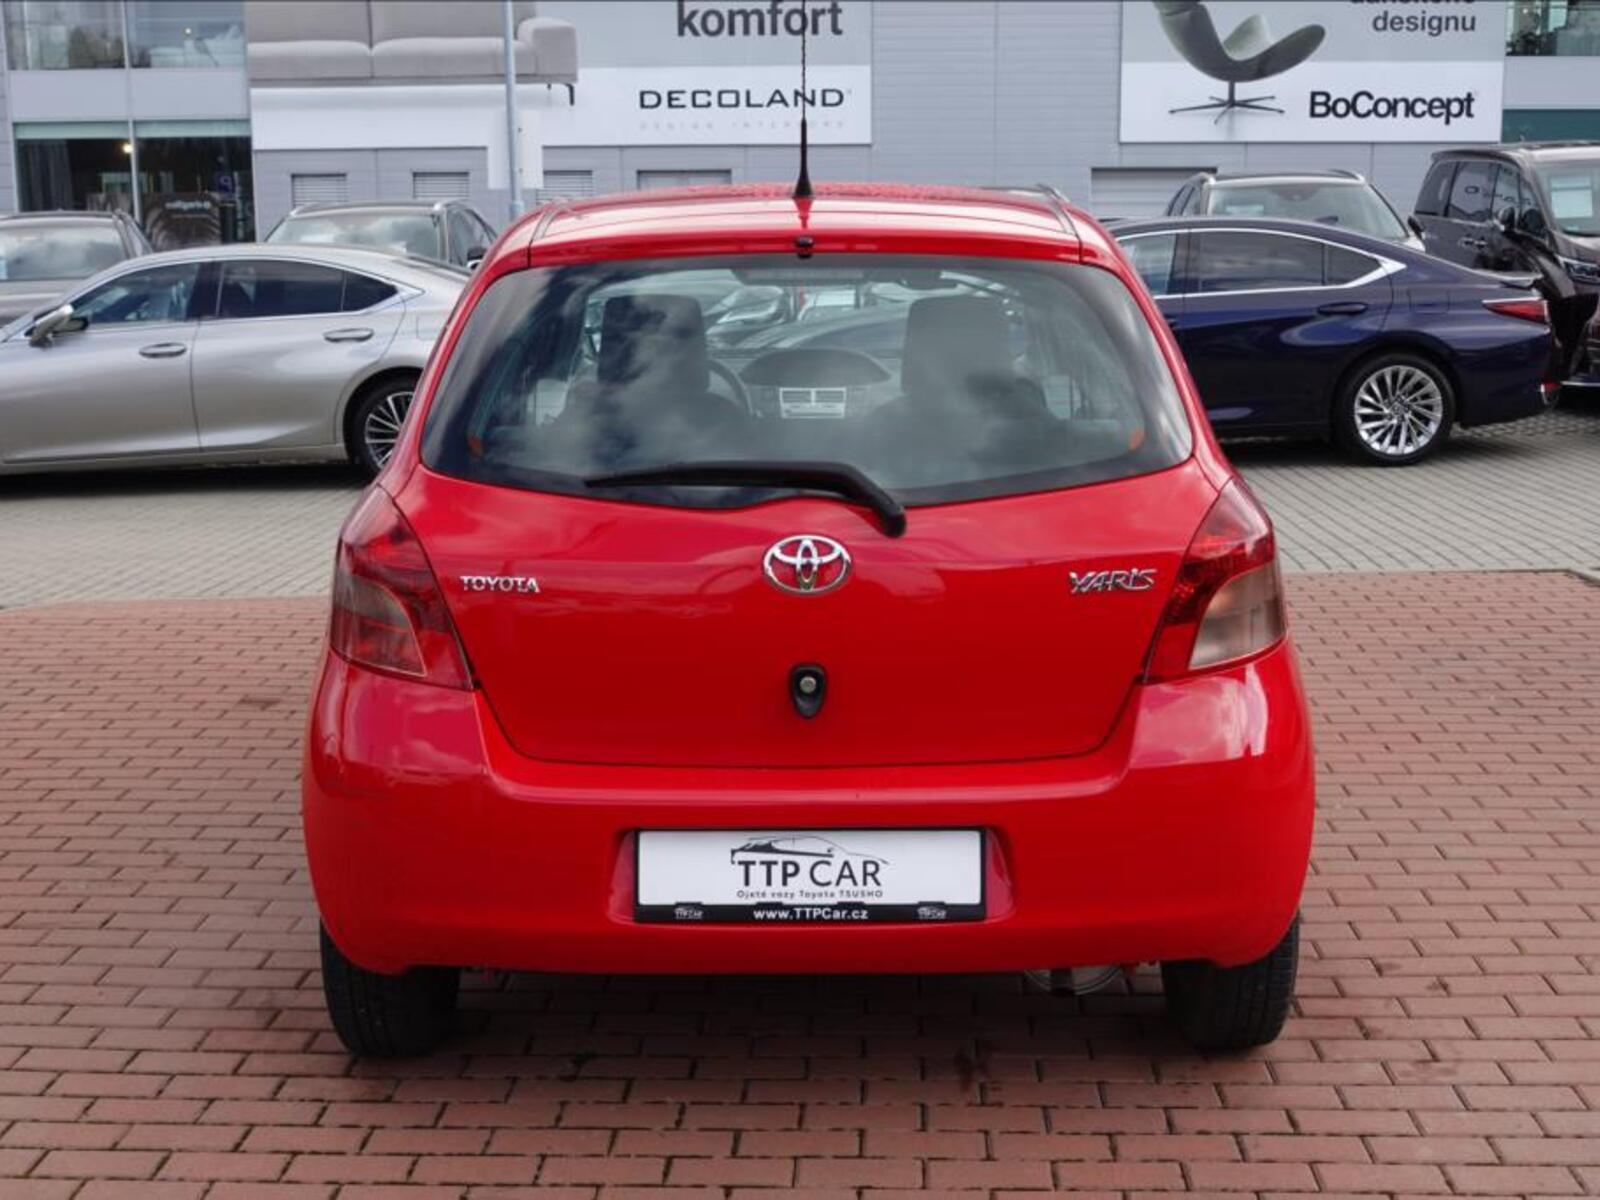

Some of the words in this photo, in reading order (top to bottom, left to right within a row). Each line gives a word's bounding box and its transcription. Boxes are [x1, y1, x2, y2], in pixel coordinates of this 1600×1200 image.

[677, 1, 843, 37] komfort
[1372, 10, 1476, 37] designu
[639, 88, 844, 109] DECOLAND
[1309, 90, 1475, 126] BoConcept
[460, 575, 541, 593] TOYOTA
[738, 860, 800, 887] TTP
[809, 860, 881, 887] CAR
[799, 890, 835, 899] Toyota
[753, 907, 869, 920] www.TTPCar.cz
